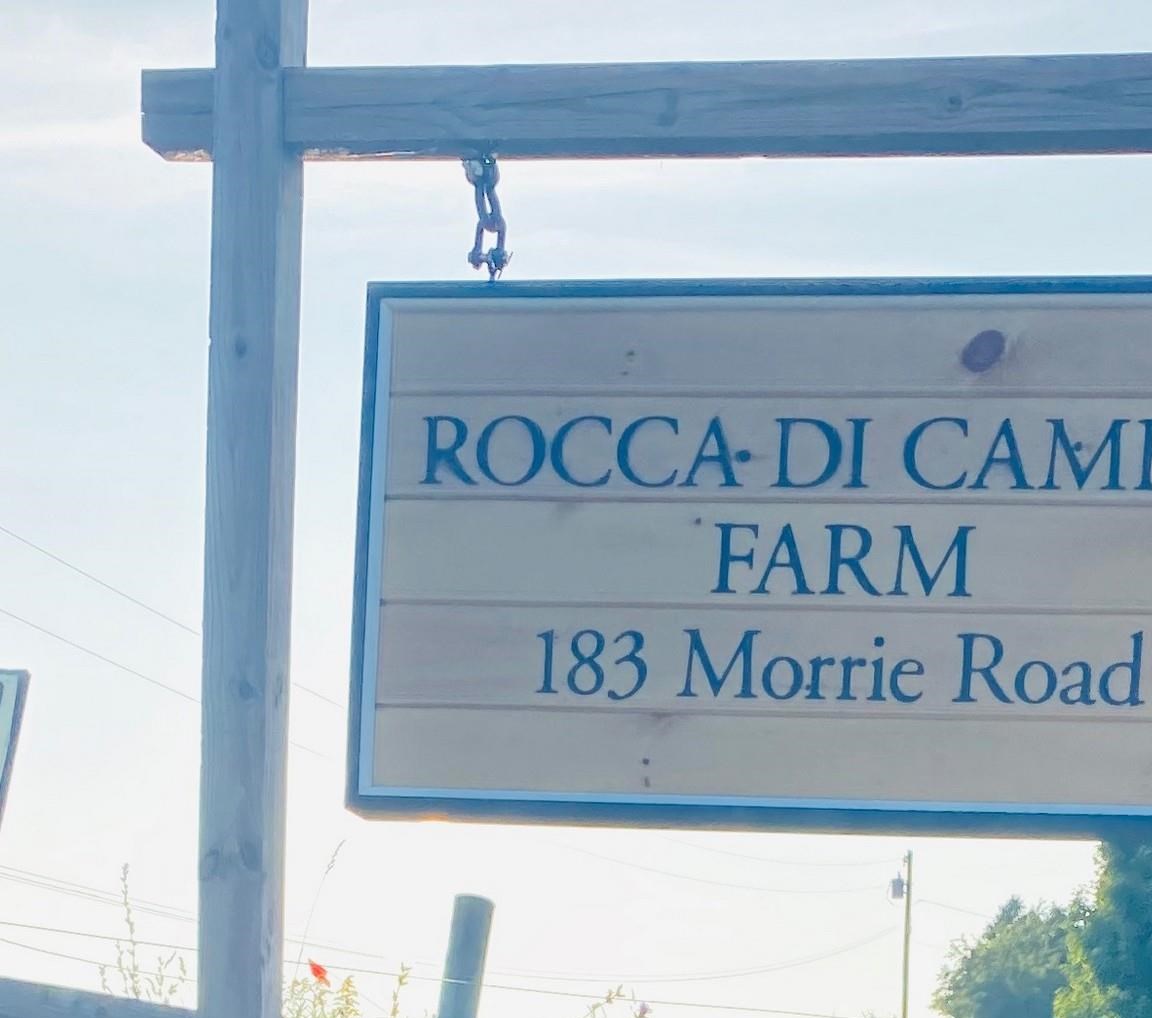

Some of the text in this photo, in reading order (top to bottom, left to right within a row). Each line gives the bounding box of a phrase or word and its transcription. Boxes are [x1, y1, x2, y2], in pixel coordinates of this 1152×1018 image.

[418, 414, 744, 489] ROCCA
[769, 417, 873, 490] DI
[710, 522, 977, 598] FARM
[535, 628, 1145, 707] 183 Morrie Road
